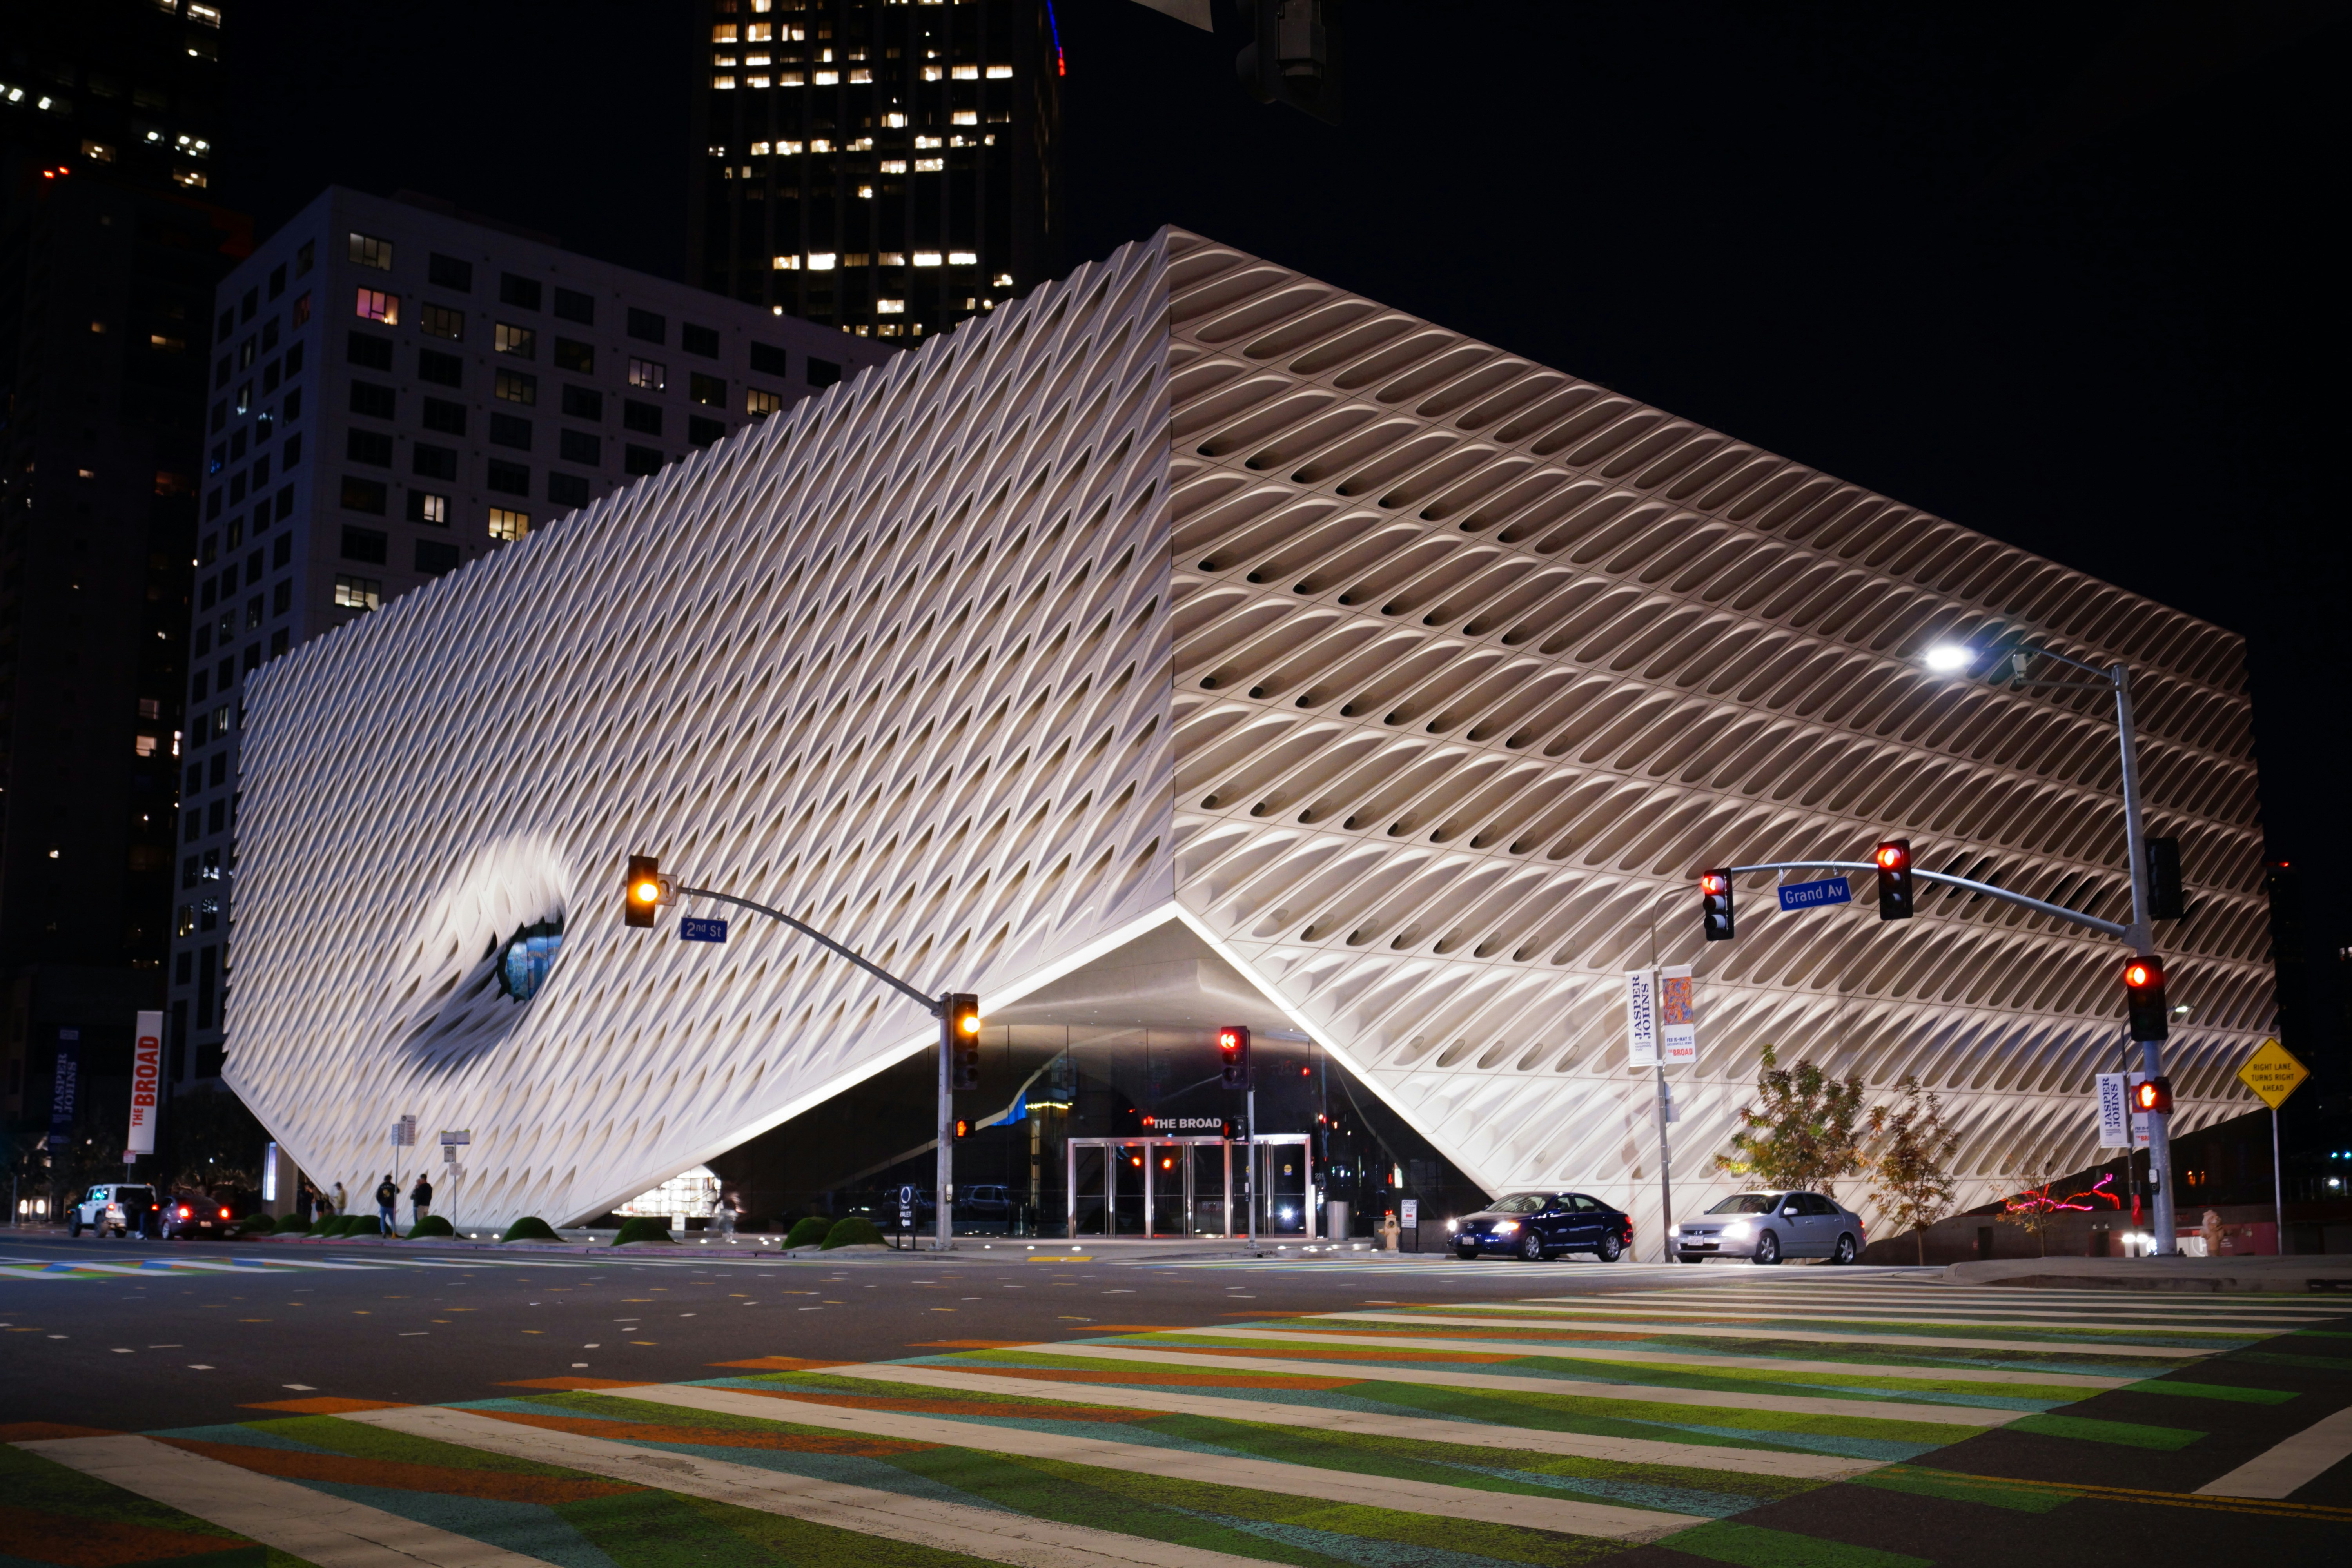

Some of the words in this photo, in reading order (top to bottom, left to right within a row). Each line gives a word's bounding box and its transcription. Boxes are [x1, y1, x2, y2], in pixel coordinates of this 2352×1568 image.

[1785, 886, 1823, 904] Grand
[1828, 884, 1842, 898] Av
[686, 922, 706, 937] 2nd
[710, 925, 721, 937] St
[1632, 975, 1642, 1039] JASPER
[1641, 983, 1651, 1039] JOHNS
[134, 1036, 159, 1106] BROAD
[1673, 1048, 1693, 1056] BROAD
[54, 1053, 67, 1113] JASPER
[64, 1062, 76, 1113] JOHNS
[2102, 1078, 2112, 1127] JASPER
[2111, 1083, 2120, 1127] JOHNS
[132, 1108, 144, 1127] THE
[1153, 1119, 1176, 1129] THE
[1179, 1118, 1222, 1128] BROAD
